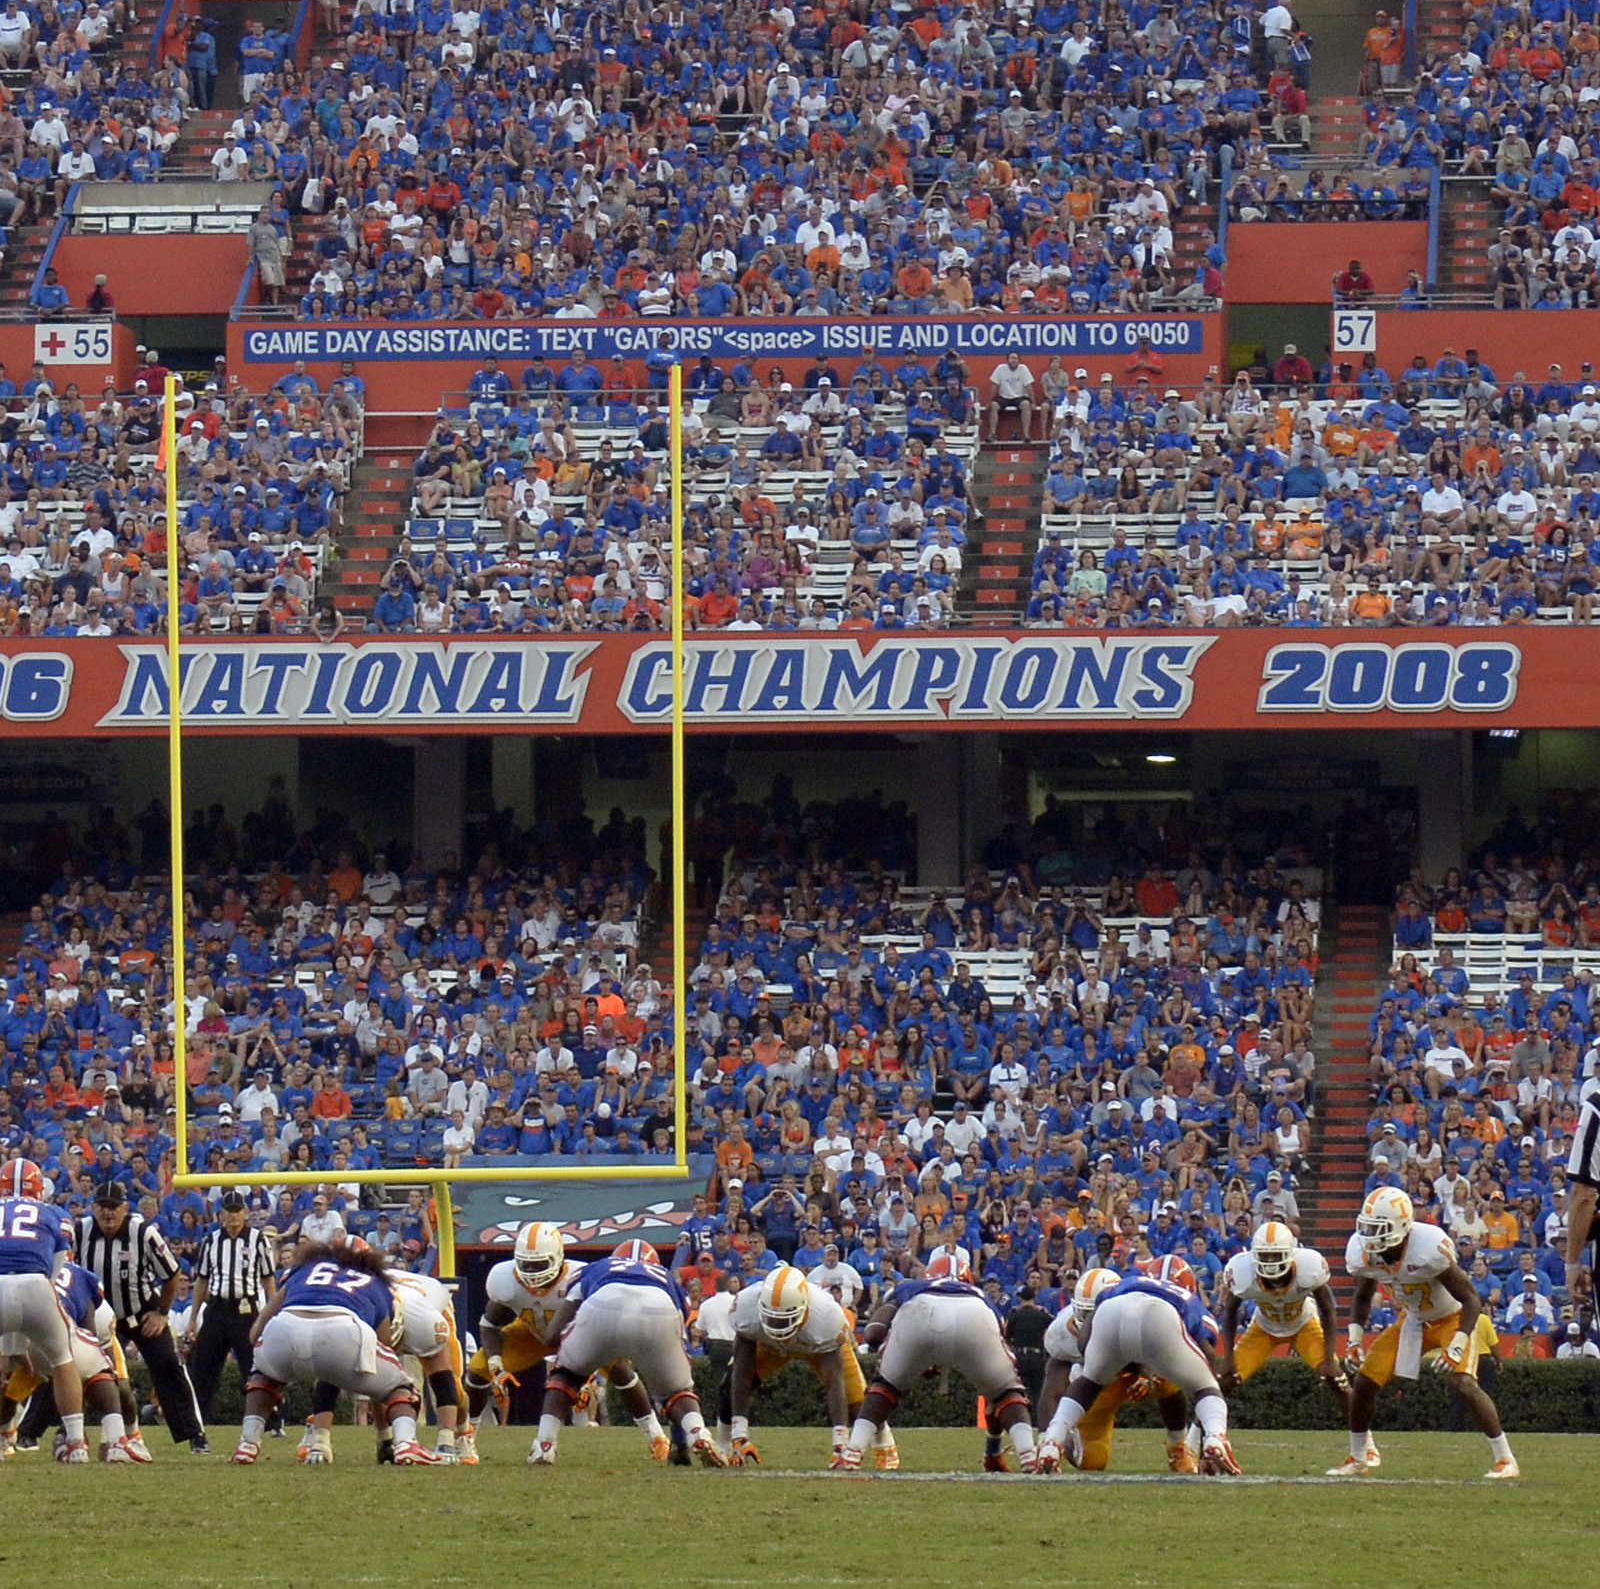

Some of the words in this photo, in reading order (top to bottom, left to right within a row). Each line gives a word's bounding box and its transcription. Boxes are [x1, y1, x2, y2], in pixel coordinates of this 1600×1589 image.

[73, 328, 110, 359] 55
[250, 331, 319, 355] GAME
[325, 331, 374, 352] DAY
[375, 328, 531, 352] ASSISTANCE:
[538, 328, 597, 351] TEXT
[823, 325, 892, 348] ISSUE
[899, 324, 949, 347] AND
[957, 323, 1077, 347] LOCATION
[1085, 323, 1118, 345] TO
[1124, 322, 1189, 345] 69050
[1336, 315, 1374, 347] 57
[481, 382, 496, 399] 15
[95, 641, 603, 727] NATIONAL
[616, 635, 1220, 723] CHAMPIONS
[1256, 642, 1521, 713] 2008
[693, 1231, 713, 1250] 15
[303, 1261, 369, 1294] 67
